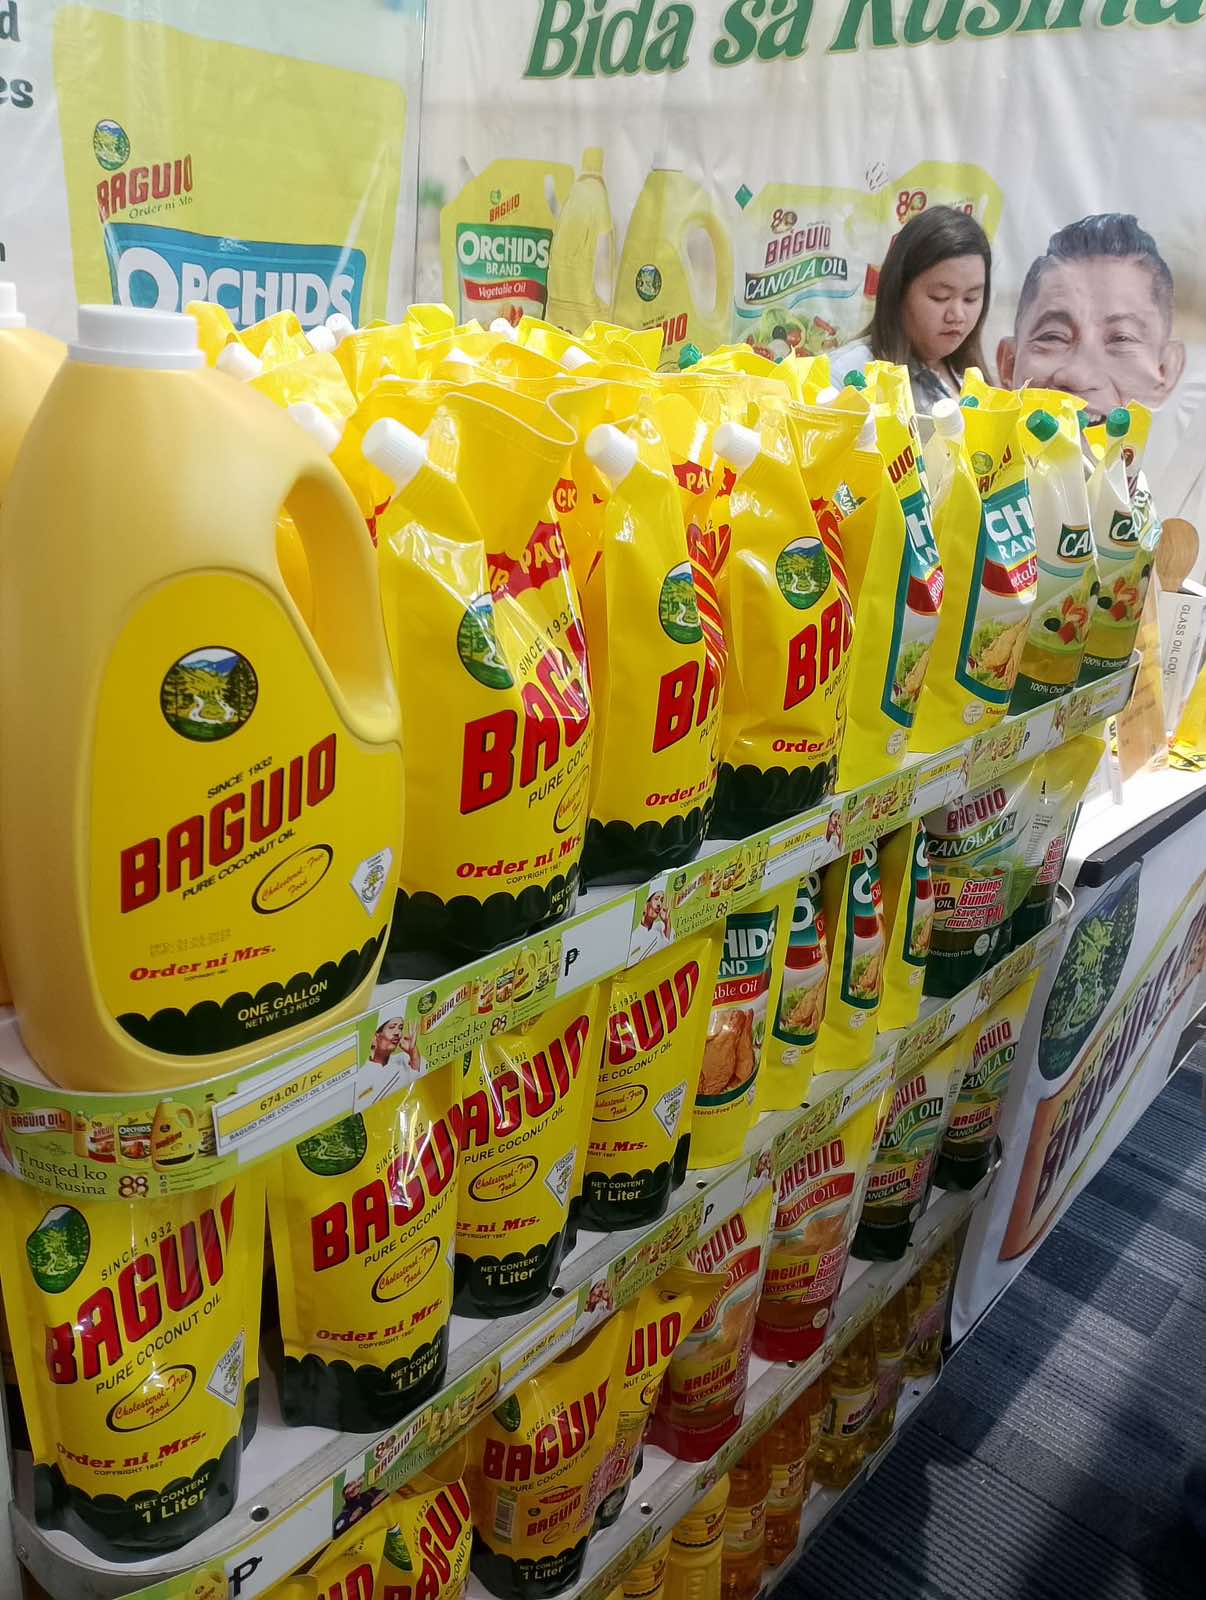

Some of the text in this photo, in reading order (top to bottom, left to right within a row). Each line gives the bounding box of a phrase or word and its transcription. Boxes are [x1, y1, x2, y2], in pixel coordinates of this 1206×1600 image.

[522, 0, 695, 79] Bida
[712, 0, 808, 66] sa
[96, 153, 194, 224] BAGUIO
[457, 231, 550, 268] ORCHIDS
[765, 225, 832, 269] BAGUIO
[485, 263, 522, 276] BRAND
[745, 256, 848, 300] CANOLA OIL
[478, 282, 527, 298] Vegetable Oil
[1174, 603, 1191, 655] GLASS OIL
[772, 738, 824, 753] Order
[207, 756, 273, 799] SINCE 1932
[528, 769, 563, 809] PURE
[645, 786, 695, 807] Order
[946, 787, 1008, 834] BAGUIO
[120, 732, 337, 914] BAGUIO
[925, 826, 995, 857] CANOLA
[182, 828, 296, 901] PURE COCONUT OIL
[456, 858, 529, 880] Order
[533, 847, 555, 868] ni
[959, 892, 997, 907] Bundle
[963, 879, 1003, 895] Savings
[936, 899, 952, 910] OIL
[955, 908, 976, 918] Save
[946, 917, 972, 928] much
[129, 963, 201, 982] Order
[205, 953, 228, 970] ni
[232, 945, 277, 964] Mrs.
[237, 979, 329, 1022] ONE GALLON
[740, 980, 758, 996] Oil
[245, 995, 322, 1030] NET WT KILOS
[601, 960, 700, 1069] GUIO
[426, 1020, 487, 1056] Trusted ko
[452, 1034, 484, 1054] kusina
[610, 1052, 659, 1083] COCONUT
[659, 1040, 673, 1056] OIL
[259, 1071, 323, 1112] 674.00 pc
[1031, 943, 1178, 1214] BAGUIO
[11, 1114, 47, 1128] BAGUIO
[47, 1113, 66, 1127] OIL
[611, 1104, 629, 1118] Food
[919, 1100, 943, 1118] OIL
[463, 1105, 565, 1166] PURE COCONUT OIL
[612, 1140, 648, 1151] Mrs.
[16, 1146, 109, 1181] Trusted ko
[375, 1144, 401, 1174] SINCE
[38, 1174, 107, 1196] sa kusina
[497, 1180, 517, 1196] Food
[591, 1179, 645, 1189] NET CONTENT
[607, 1188, 641, 1202] Liter
[780, 1197, 810, 1227] PALM
[813, 1183, 839, 1207] OIL
[363, 1197, 450, 1268] PURE COCONUT
[476, 1214, 541, 1233] ni Mrs.
[102, 1221, 173, 1282] SINCE 1932
[481, 1255, 540, 1274] NET CONTENT
[402, 1267, 423, 1285] Food
[485, 1266, 536, 1287] 1 Liter
[316, 1299, 444, 1343] Order ni Mrs.
[96, 1295, 222, 1395] PURE COCONUT OIL
[358, 1338, 401, 1350] COPYRIGHT
[391, 1339, 442, 1381] NET CONTENT
[409, 1355, 439, 1385] Liter
[640, 1371, 653, 1382] OIL
[145, 1398, 171, 1418] Food
[526, 1416, 546, 1441] SINCE
[56, 1431, 207, 1469] Order ni Mrs.
[94, 1464, 144, 1476] COPYRIGHT
[536, 1455, 579, 1491] COCONUT
[135, 1473, 210, 1511] NET CONTENT
[141, 1486, 207, 1524] 1 Liter
[526, 1496, 582, 1537] BAGUIO
[534, 1566, 564, 1580] Liter
